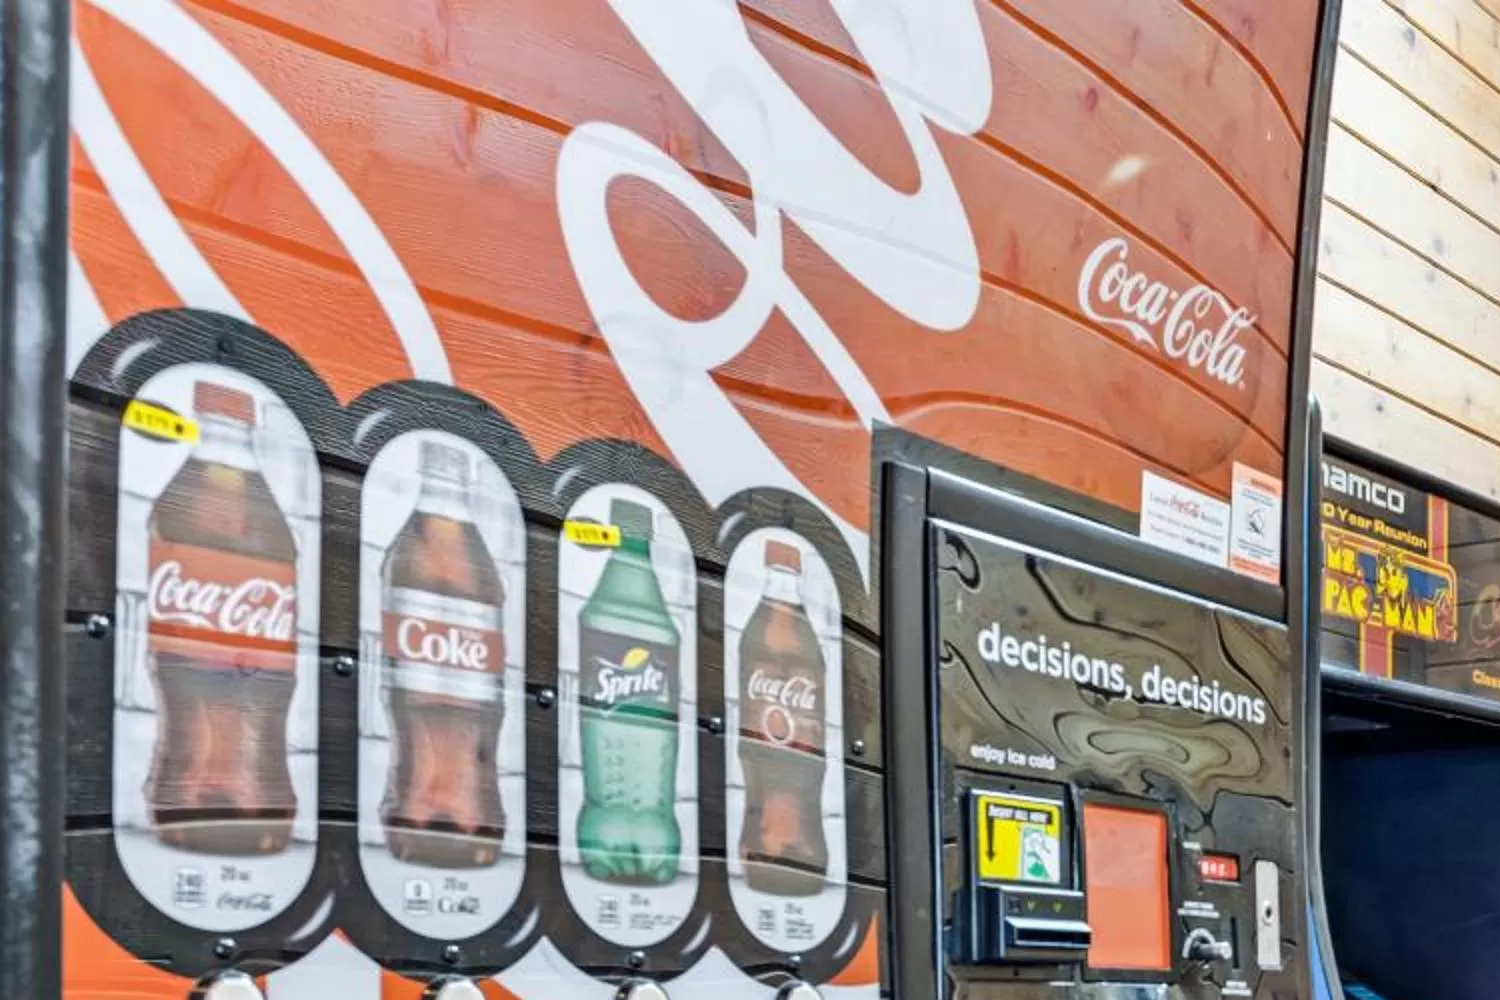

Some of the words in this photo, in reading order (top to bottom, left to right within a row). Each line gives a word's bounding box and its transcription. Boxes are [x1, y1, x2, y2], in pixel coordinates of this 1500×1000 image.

[1078, 237, 1258, 385] Coca-Cola
[1337, 507, 1372, 529] Year
[1374, 519, 1427, 550] Reunion
[150, 560, 296, 641] Coca-Cola
[398, 618, 489, 670] Coke
[594, 664, 664, 703] Sprite
[748, 670, 816, 709] Coca-Cola
[977, 622, 1134, 701] decisions,
[1141, 664, 1267, 725] decisions
[970, 744, 1005, 765] enjoy
[1007, 748, 1026, 766] ice
[1028, 754, 1057, 771] cold
